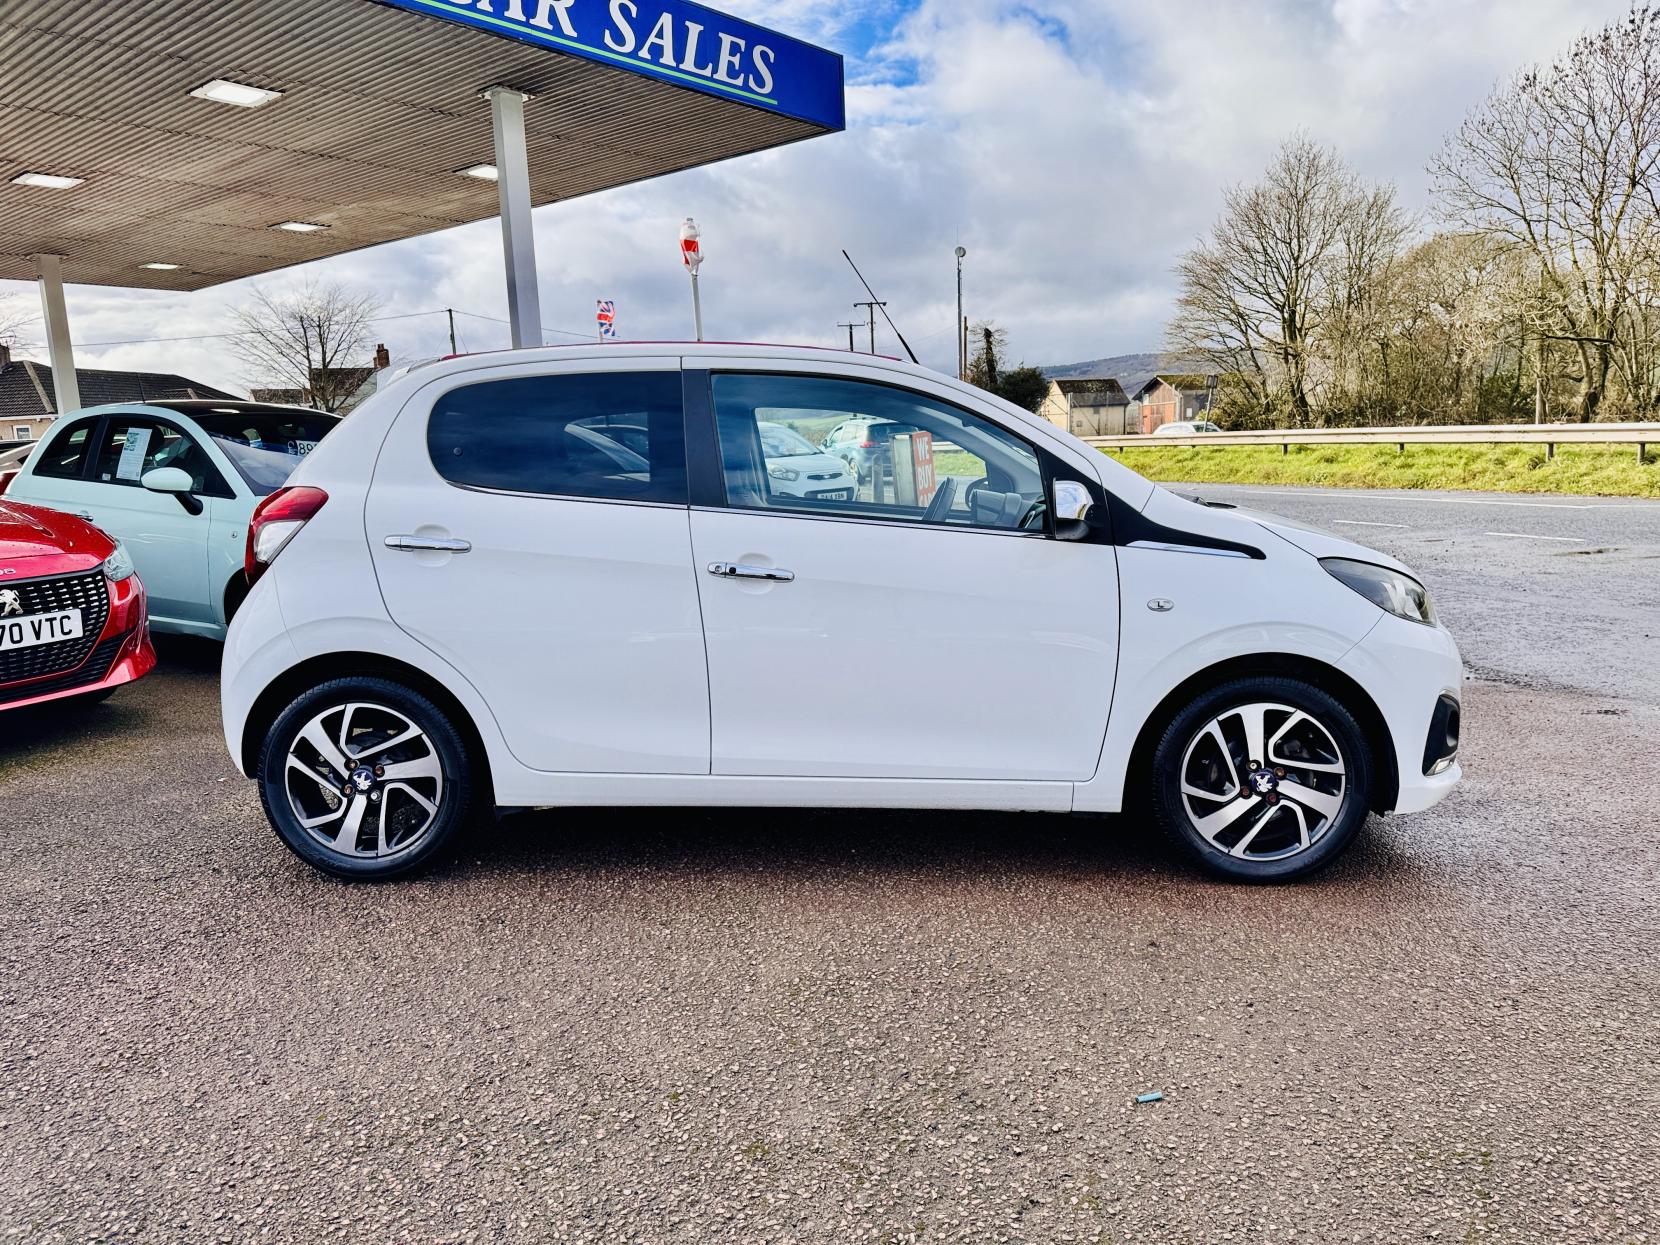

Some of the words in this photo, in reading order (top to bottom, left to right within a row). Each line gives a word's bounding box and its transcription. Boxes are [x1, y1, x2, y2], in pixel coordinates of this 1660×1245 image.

[604, 0, 775, 94] SALES
[916, 436, 930, 461] WE
[917, 464, 933, 490] BUY
[30, 615, 73, 641] VTC
